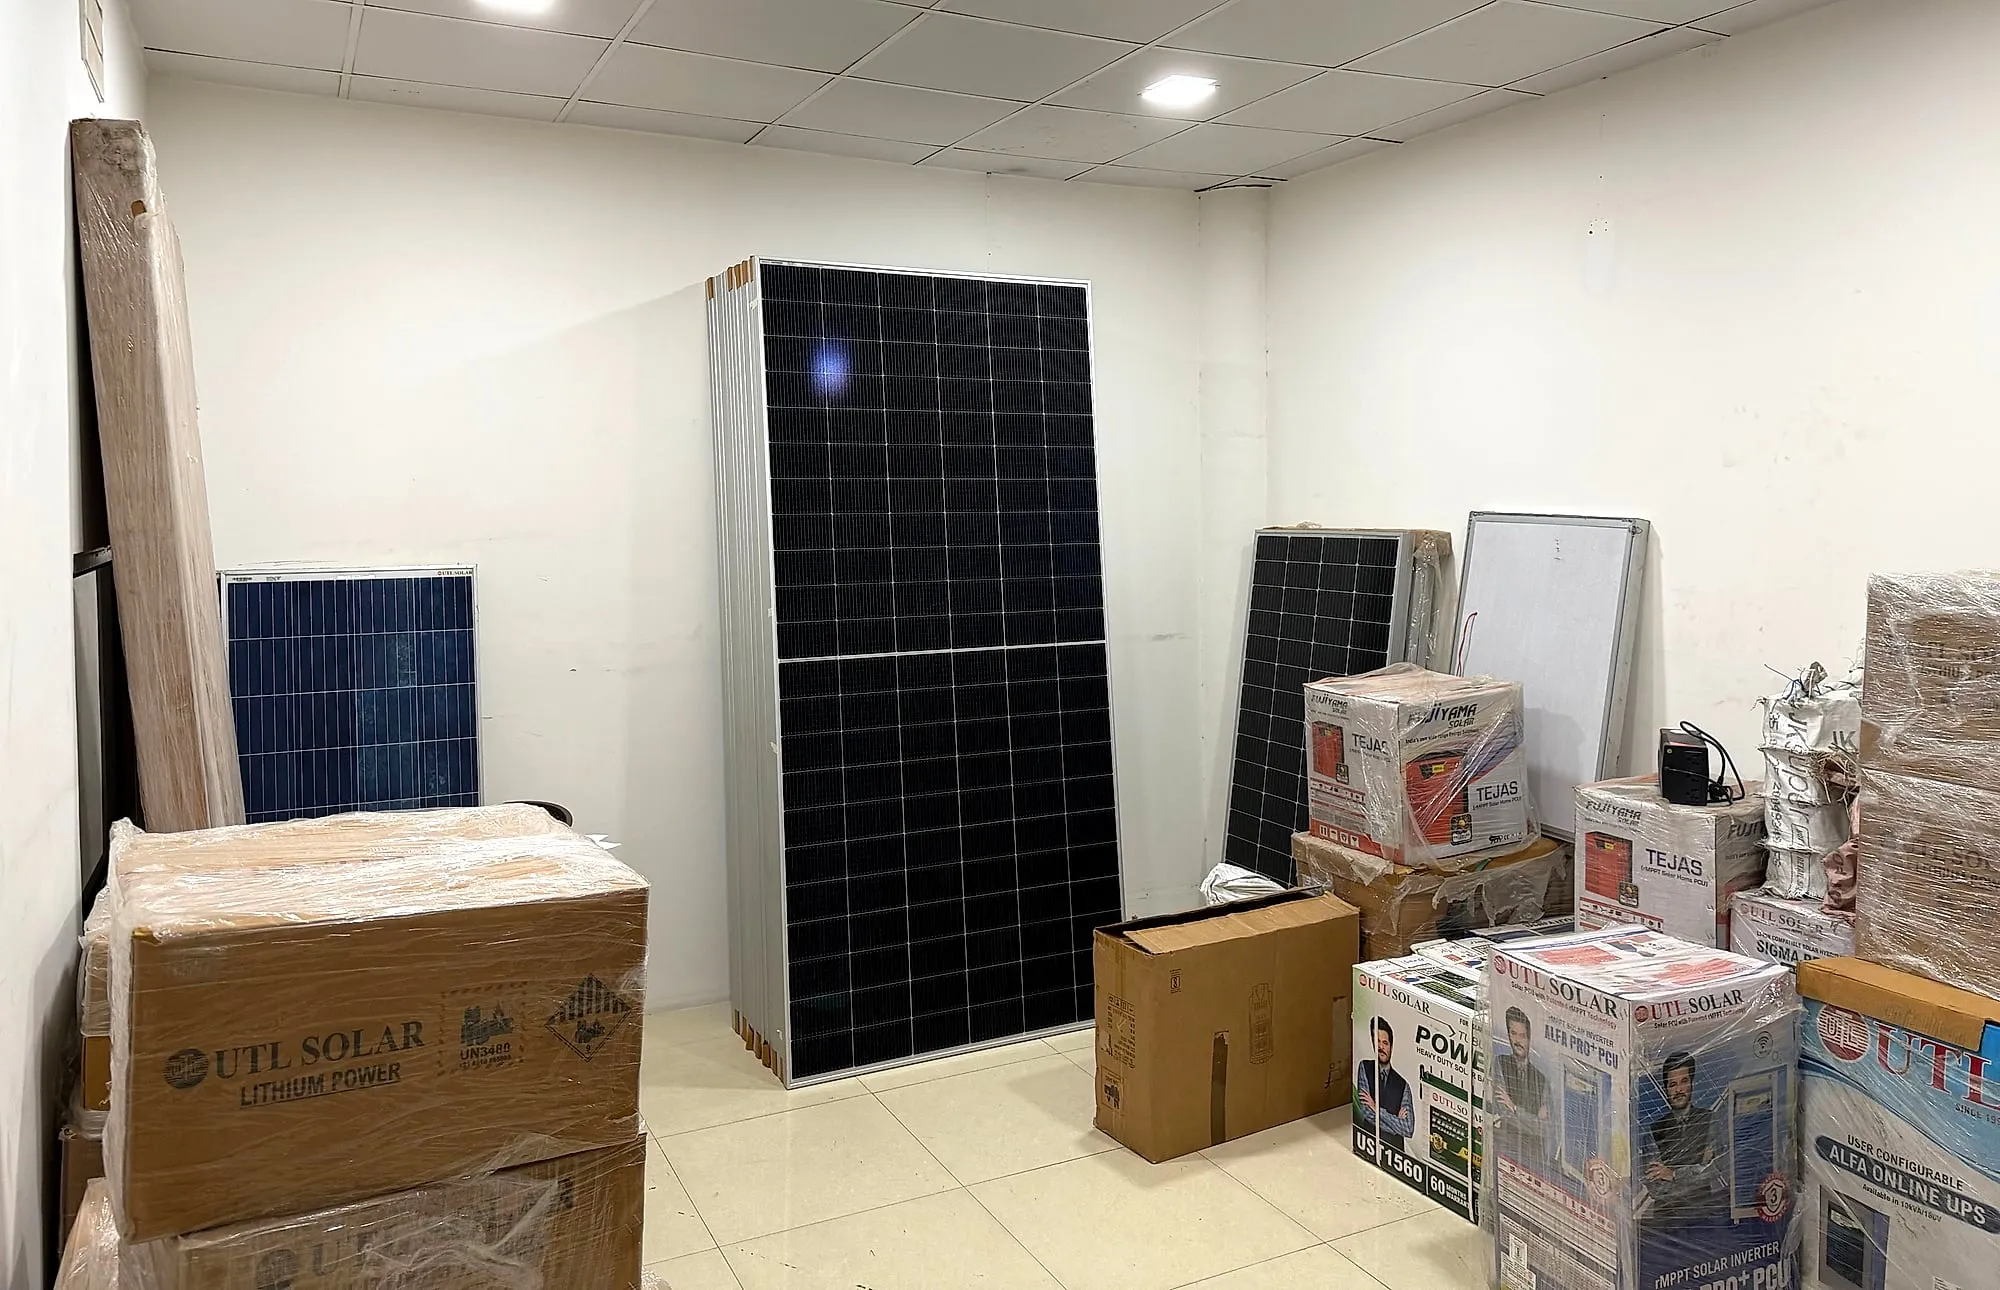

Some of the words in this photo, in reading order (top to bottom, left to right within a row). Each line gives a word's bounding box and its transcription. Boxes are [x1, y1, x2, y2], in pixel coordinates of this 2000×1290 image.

[1352, 732, 1389, 756] TEJAS
[1476, 780, 1519, 802] TEJAS
[1645, 847, 1703, 877] TEJAS
[1756, 939, 1799, 962] SIGMA
[1391, 988, 1431, 1015] SOLAR
[1508, 959, 1546, 991] UTL
[1549, 977, 1619, 1020] SOLAR
[1651, 1000, 1687, 1021] UTL
[1688, 989, 1745, 1014] SOLAR
[215, 1041, 293, 1080] UTL
[301, 1020, 426, 1067] SOLAR
[460, 1041, 511, 1061] UN3480
[1543, 1023, 1568, 1049] ALFA
[1598, 1046, 1620, 1070] PCU
[1416, 1045, 1437, 1060] HEAVY
[1436, 1056, 1455, 1069] DUTY
[1454, 1063, 1477, 1080] SOLR
[1873, 1020, 2000, 1111] UTL
[240, 1071, 325, 1107] LITHIUM
[331, 1061, 401, 1092] POWER
[1955, 1102, 1983, 1119] SINCE
[1846, 1134, 1874, 1156] USER
[1876, 1147, 1965, 1192] CONFIGURABLE
[1430, 1174, 1446, 1197] 60
[1446, 1183, 1467, 1201] MONTHS
[1770, 1187, 1778, 1204] 3
[1829, 1144, 1868, 1176] ALFA
[1872, 1163, 1941, 1208] ONLINE
[1945, 1194, 1987, 1226] UPS
[1862, 1183, 1892, 1203] Available
[1892, 1197, 1900, 1207] in
[1655, 1267, 1691, 1290] rMPPT
[1693, 1257, 1729, 1279] SOLAR
[1730, 1241, 1781, 1268] INVERTER
